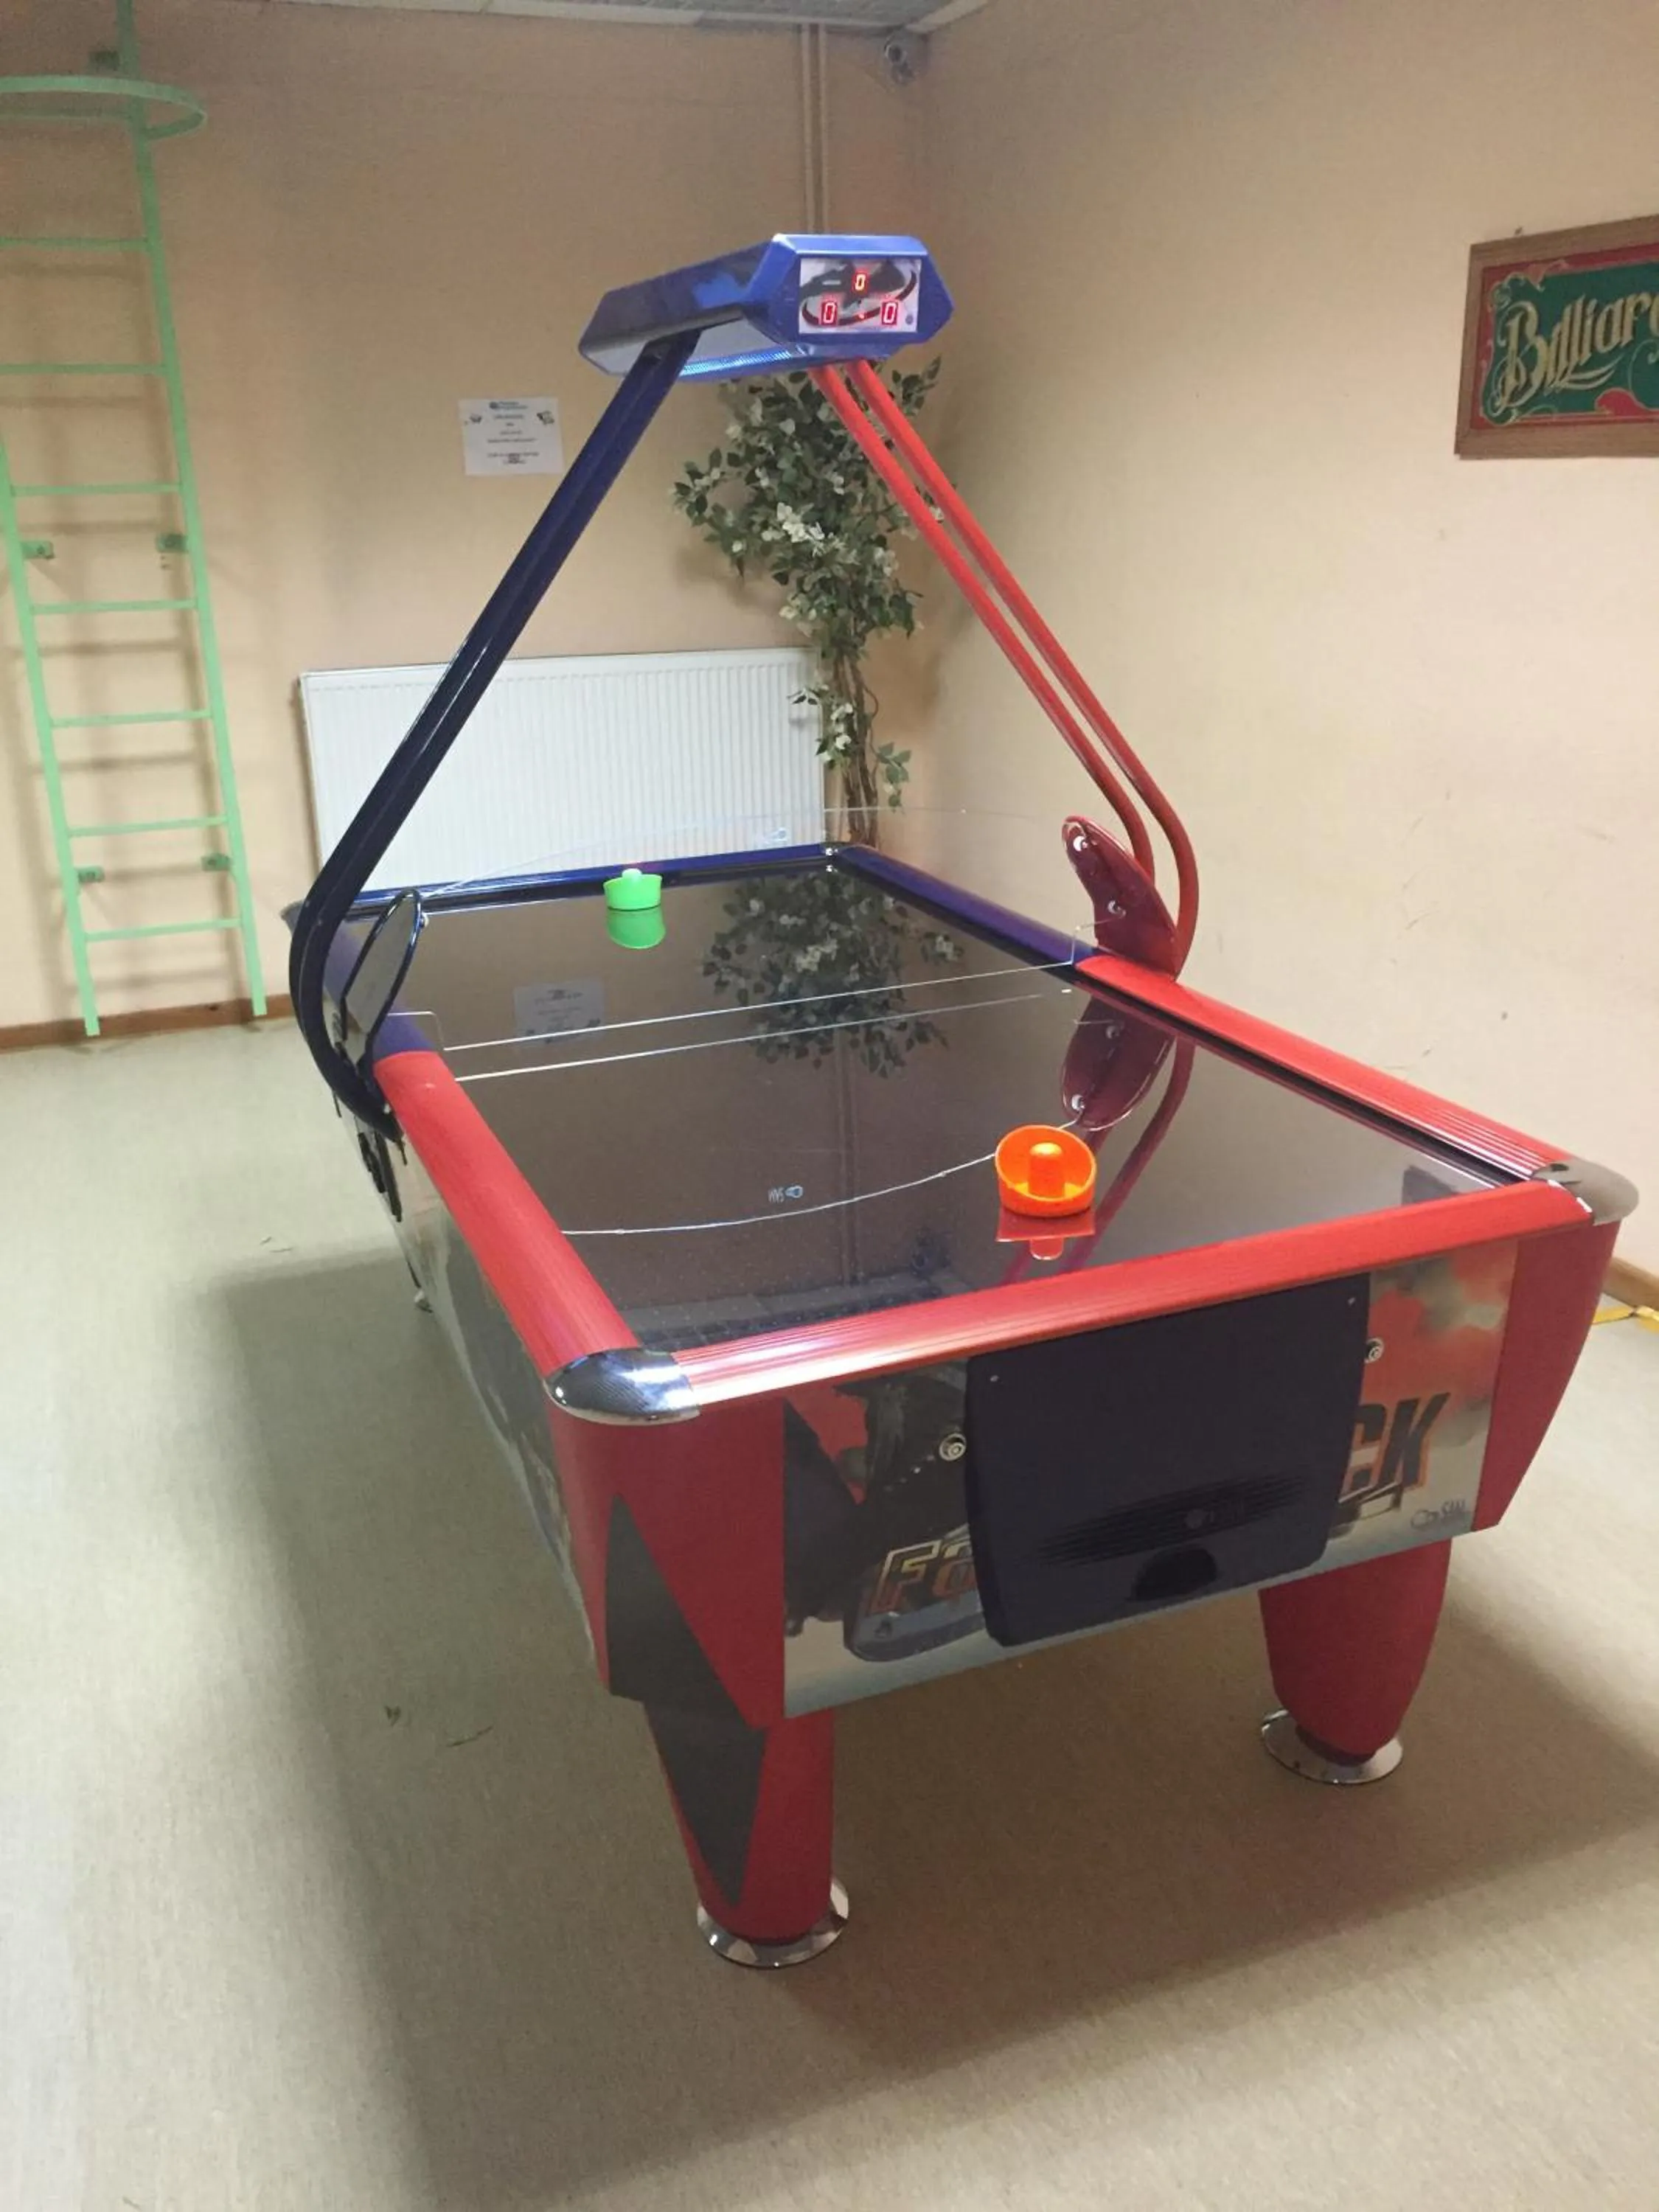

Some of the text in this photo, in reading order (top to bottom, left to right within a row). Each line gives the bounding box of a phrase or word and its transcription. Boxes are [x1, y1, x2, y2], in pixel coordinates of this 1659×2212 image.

[855, 274, 866, 291] 0
[823, 302, 897, 324] 0 0
